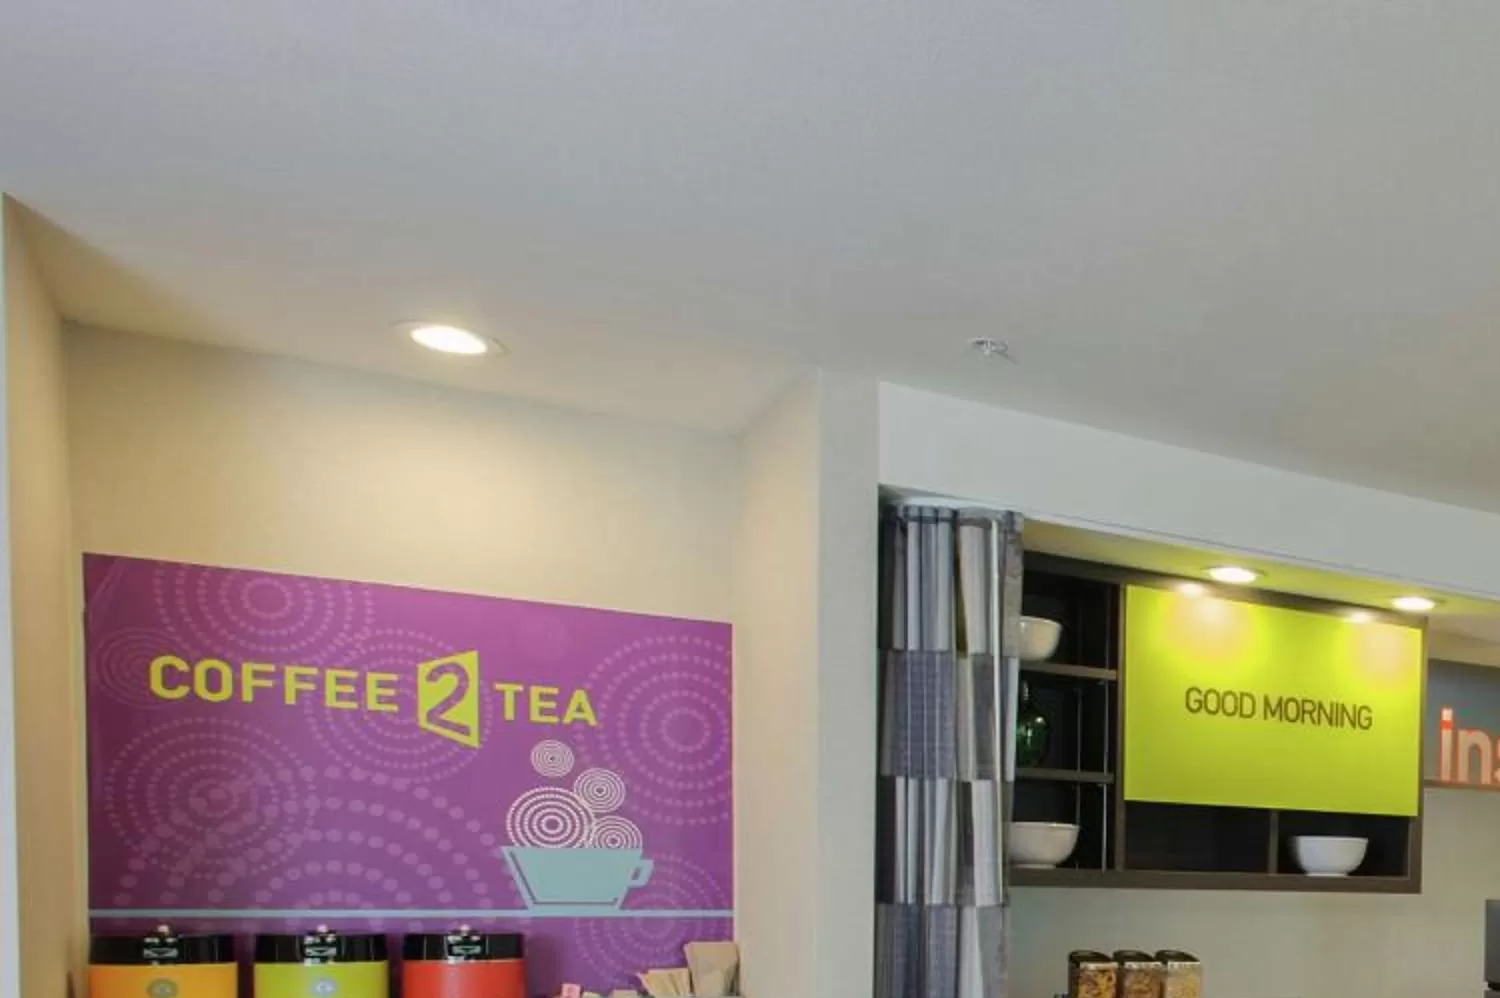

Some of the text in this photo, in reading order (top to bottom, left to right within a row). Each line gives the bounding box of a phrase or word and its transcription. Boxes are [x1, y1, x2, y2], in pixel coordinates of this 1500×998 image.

[150, 655, 598, 737] COFFEE 2 TEA
[1185, 686, 1374, 731] GOOD MORNING
